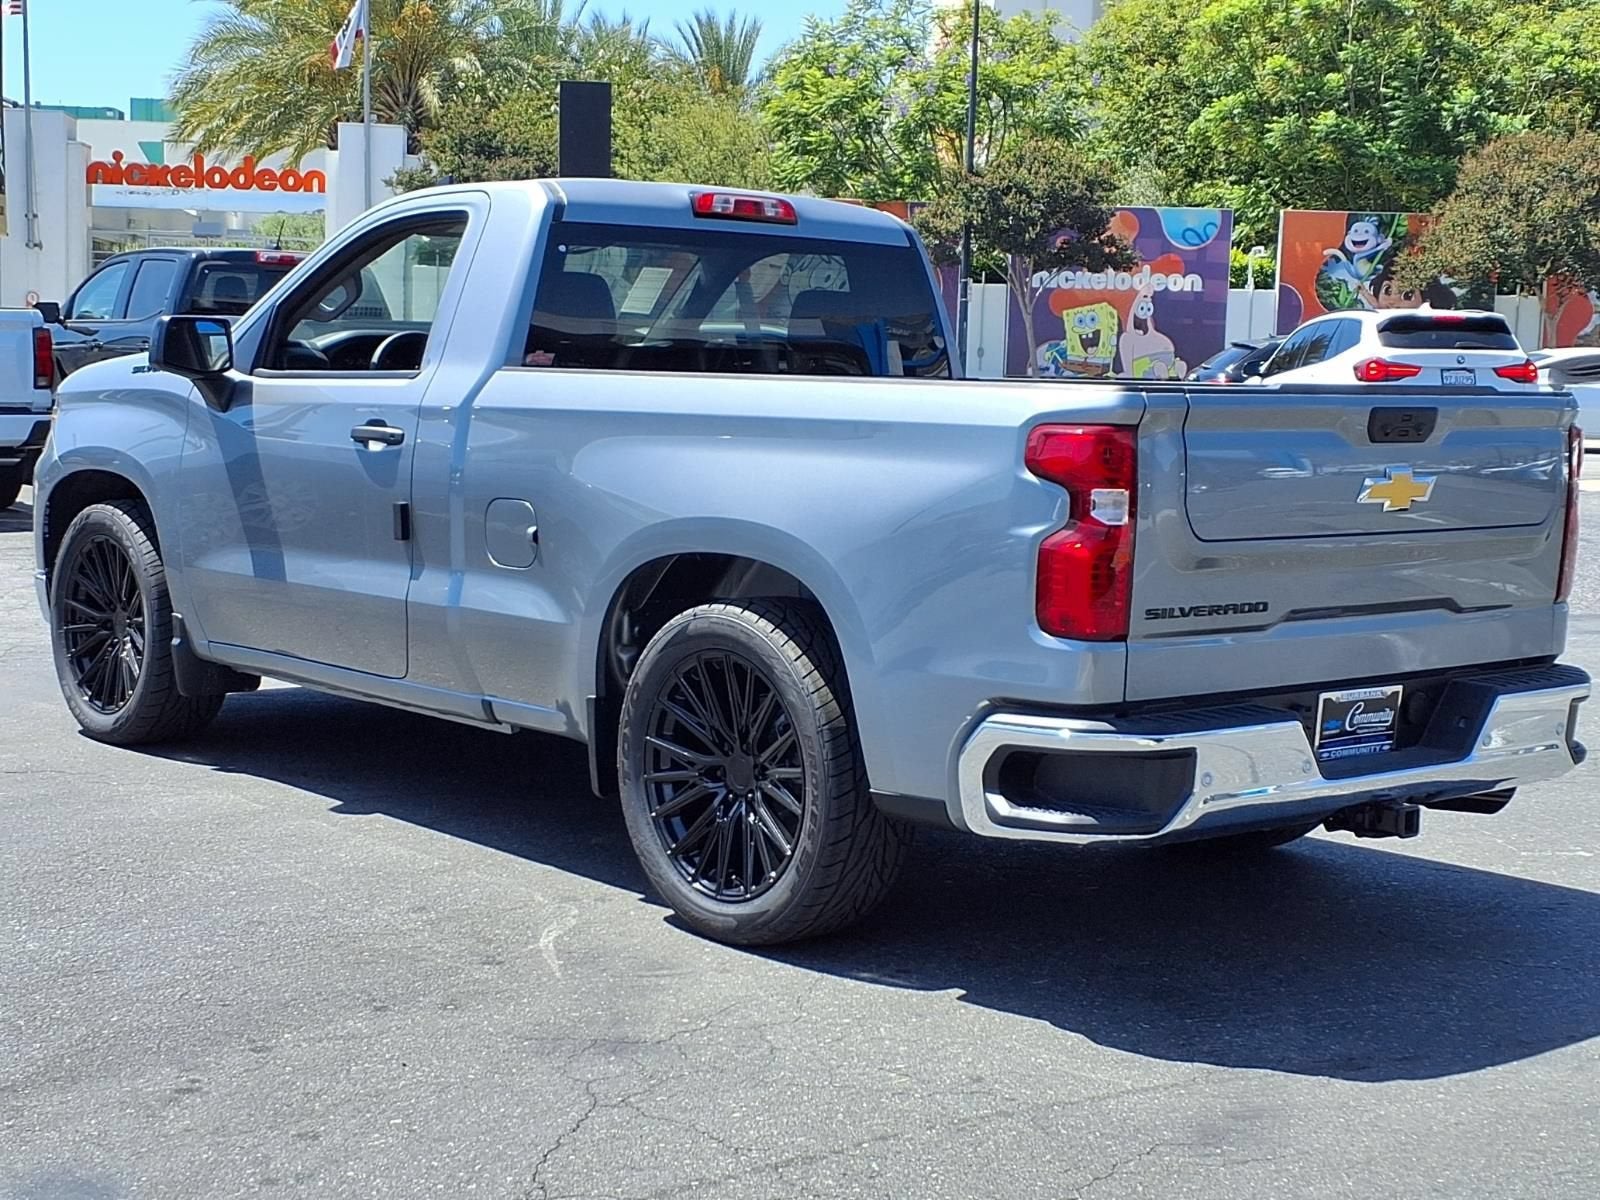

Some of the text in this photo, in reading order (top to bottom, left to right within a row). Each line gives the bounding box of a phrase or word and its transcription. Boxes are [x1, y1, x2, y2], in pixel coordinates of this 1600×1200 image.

[86, 150, 326, 193] nickelodeon
[1032, 264, 1203, 292] nickelodeon
[1144, 601, 1269, 621] SILVERADO
[1330, 745, 1381, 758] COMMUNITY
